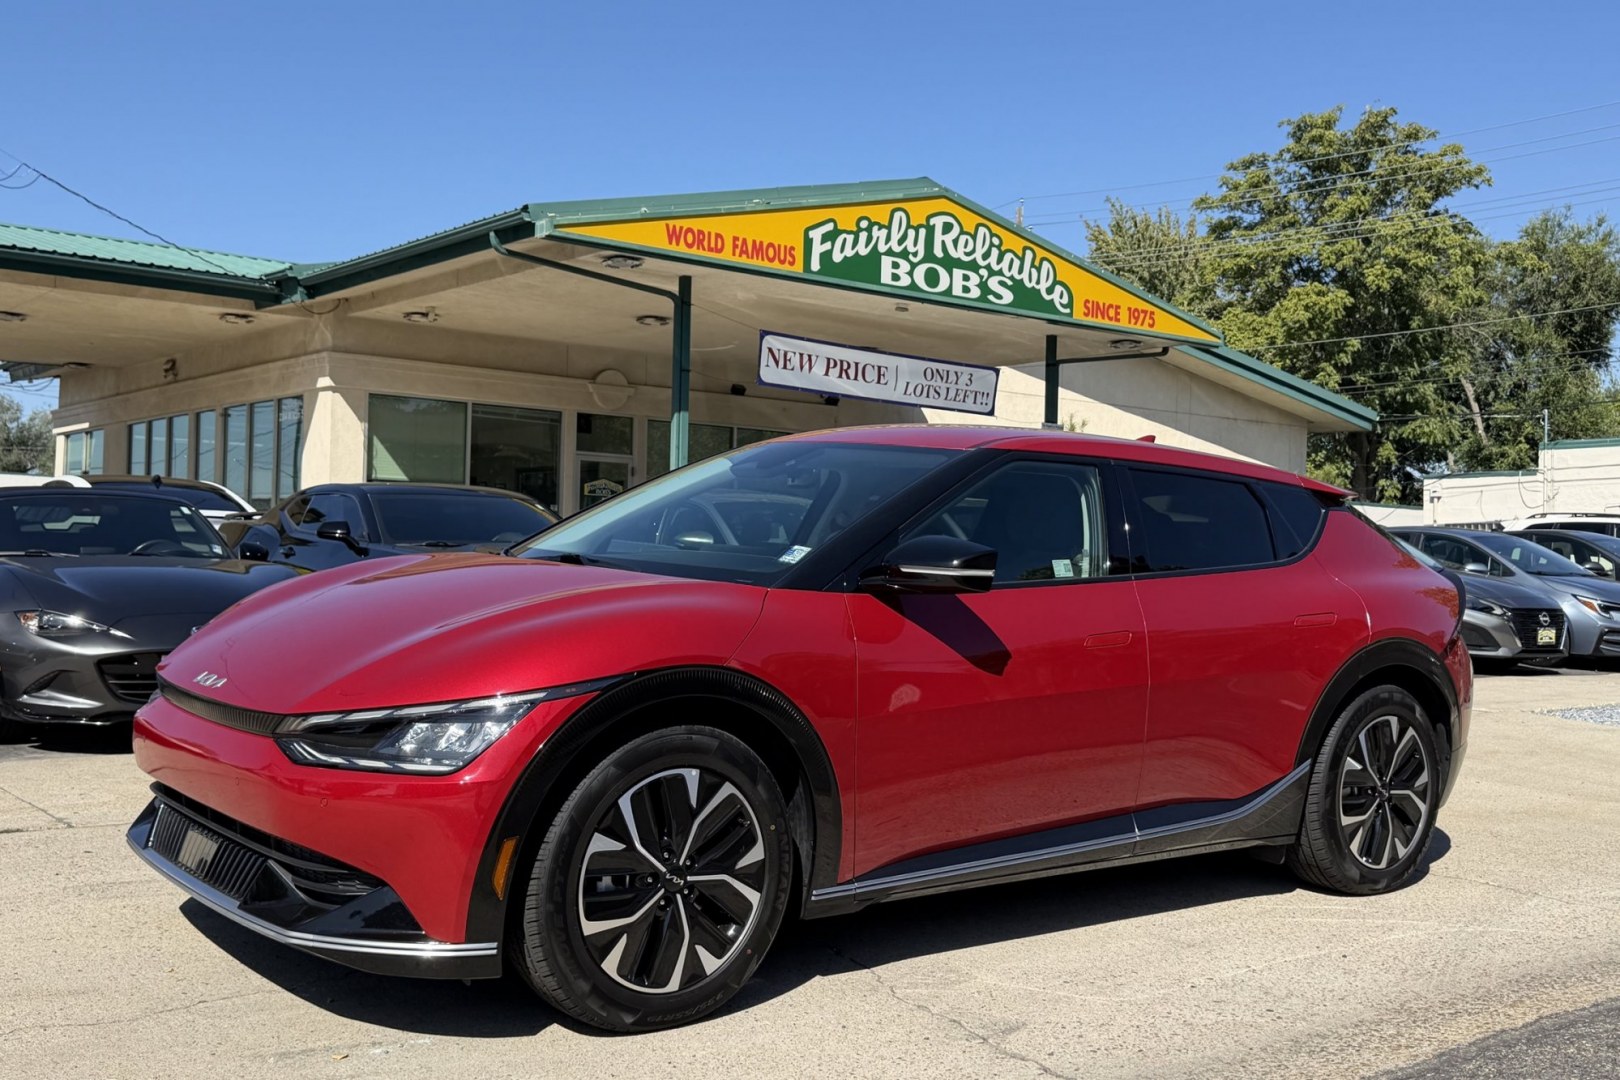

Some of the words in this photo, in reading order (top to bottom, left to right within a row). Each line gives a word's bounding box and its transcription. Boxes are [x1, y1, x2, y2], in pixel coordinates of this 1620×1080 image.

[665, 223, 725, 254] WORLD
[732, 236, 796, 267] FAMOUS
[808, 211, 926, 272] Fairly
[928, 214, 1071, 314] Reliable
[880, 255, 1014, 305] BOB'S
[1083, 299, 1121, 323] SINCE
[1127, 306, 1156, 329] 1975
[765, 347, 819, 376] NEW
[823, 357, 889, 386] PRICE
[923, 366, 964, 385] ONLY
[965, 373, 974, 387] 3
[903, 381, 942, 401] LOTS
[945, 387, 990, 406] LEFT!!
